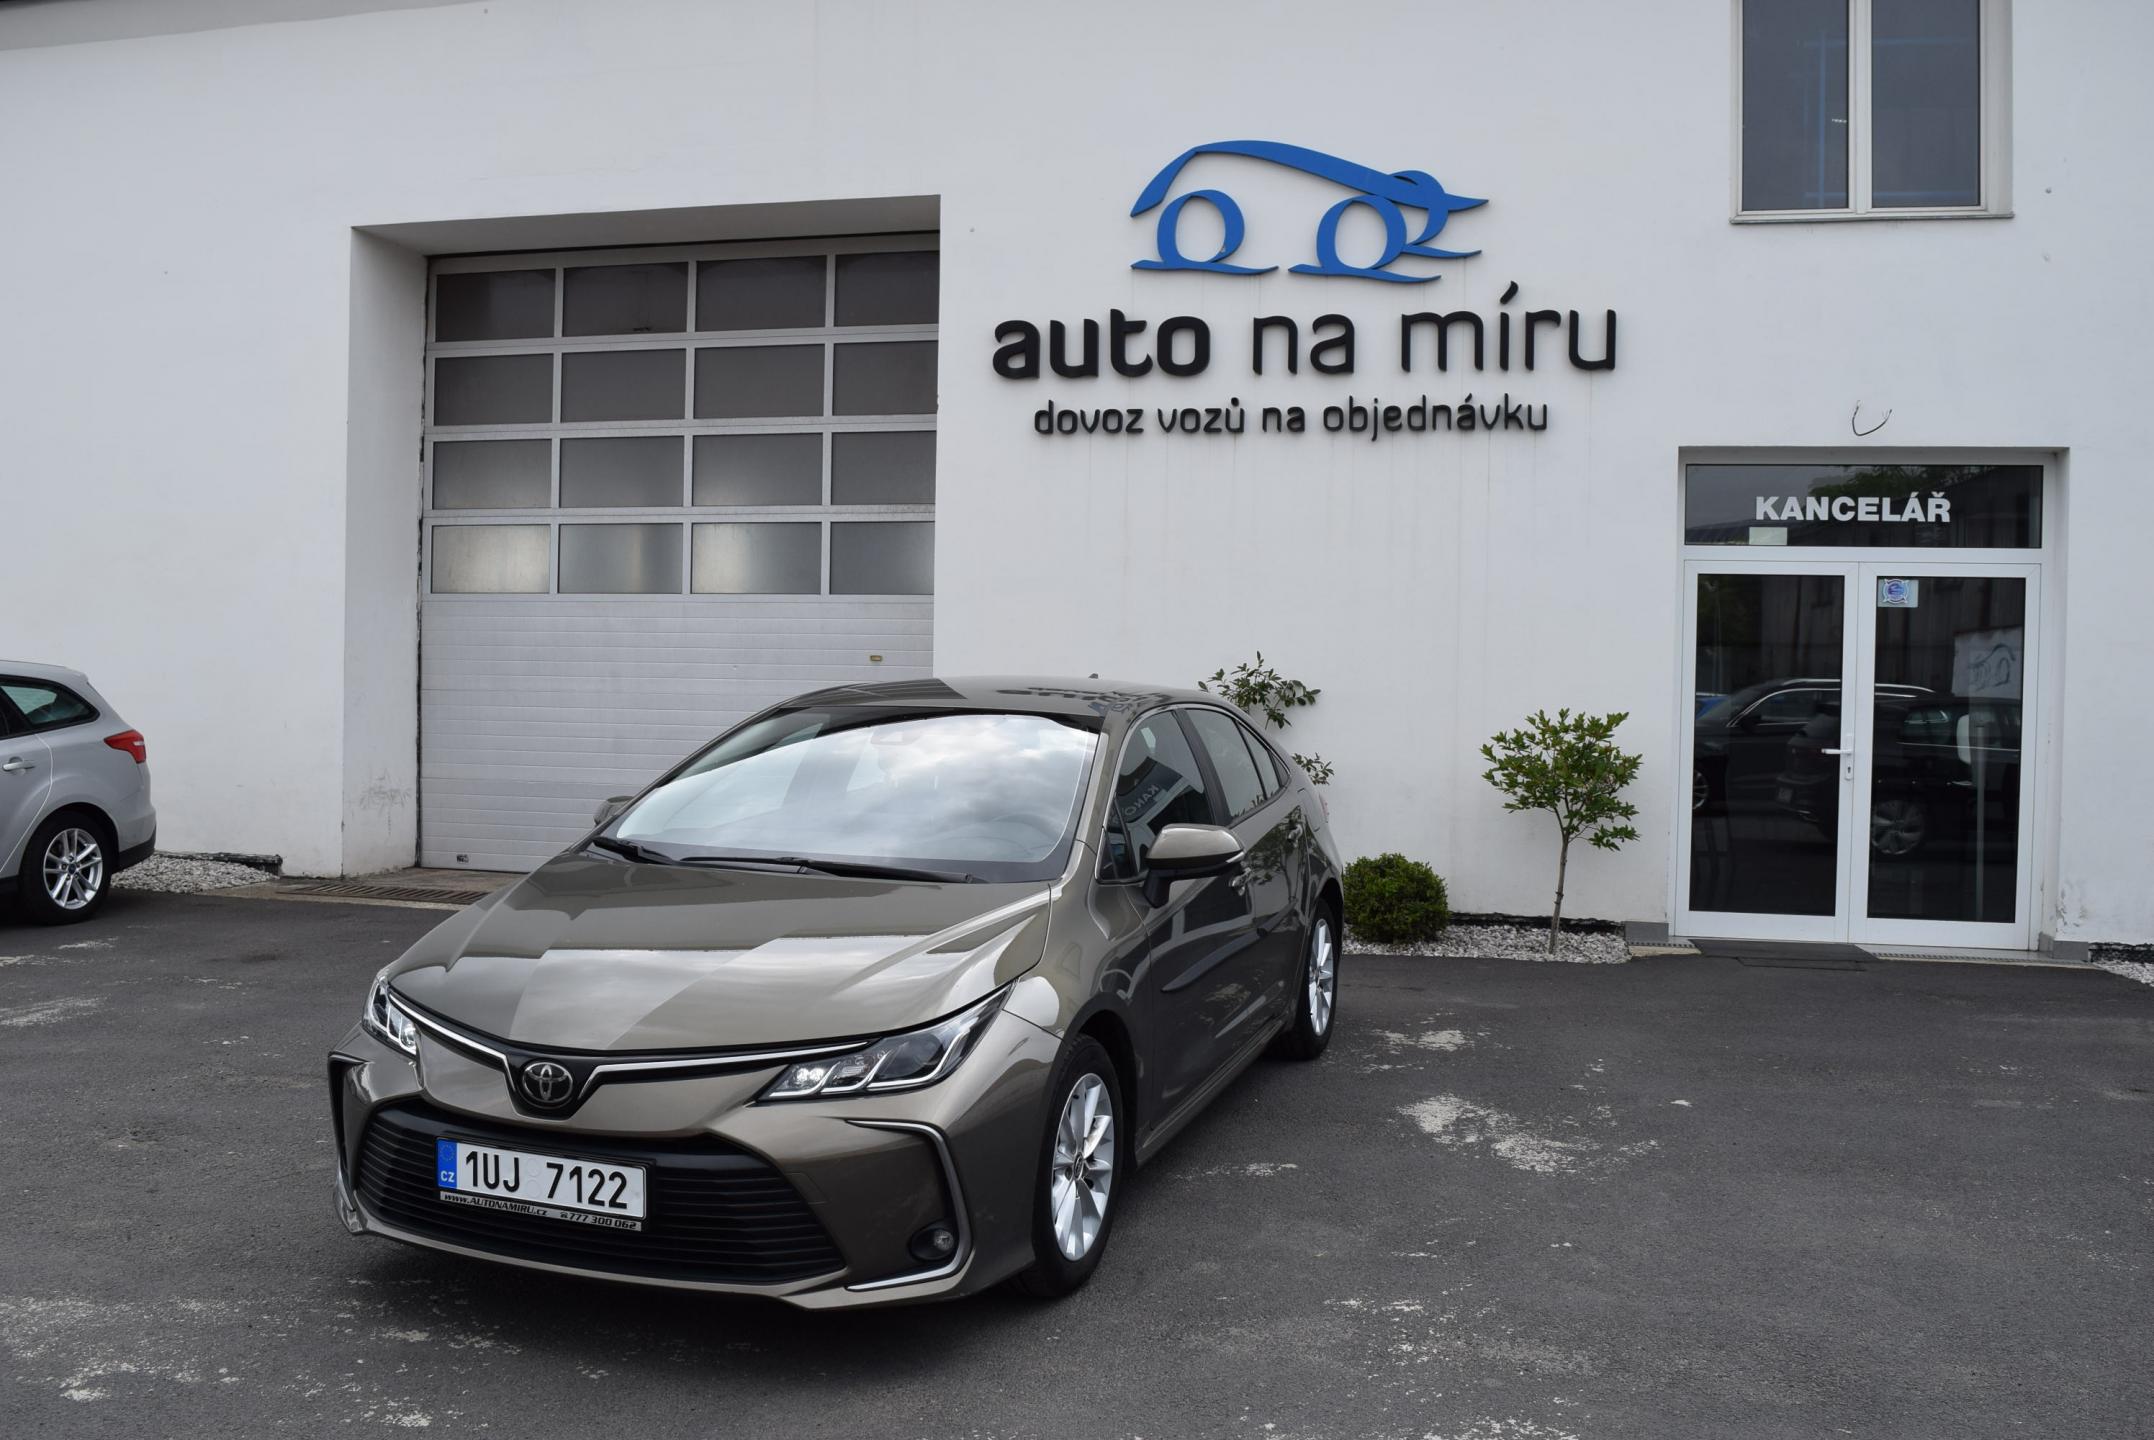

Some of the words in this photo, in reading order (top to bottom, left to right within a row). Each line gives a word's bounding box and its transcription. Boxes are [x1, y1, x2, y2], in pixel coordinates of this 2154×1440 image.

[993, 309, 1210, 380] auto
[1253, 314, 1354, 376] na
[1402, 281, 1617, 372] míru
[1035, 400, 1144, 436] dovoz
[1158, 398, 1244, 435] vozů
[1262, 407, 1305, 434] na
[1323, 393, 1548, 442] objednávku
[1755, 491, 1951, 523] KANCELÁŘ
[440, 1170, 455, 1183] CZ
[466, 1151, 520, 1193] 1UJ
[547, 1162, 628, 1210] 7122
[569, 1212, 588, 1222] 777
[591, 1215, 612, 1225] 300
